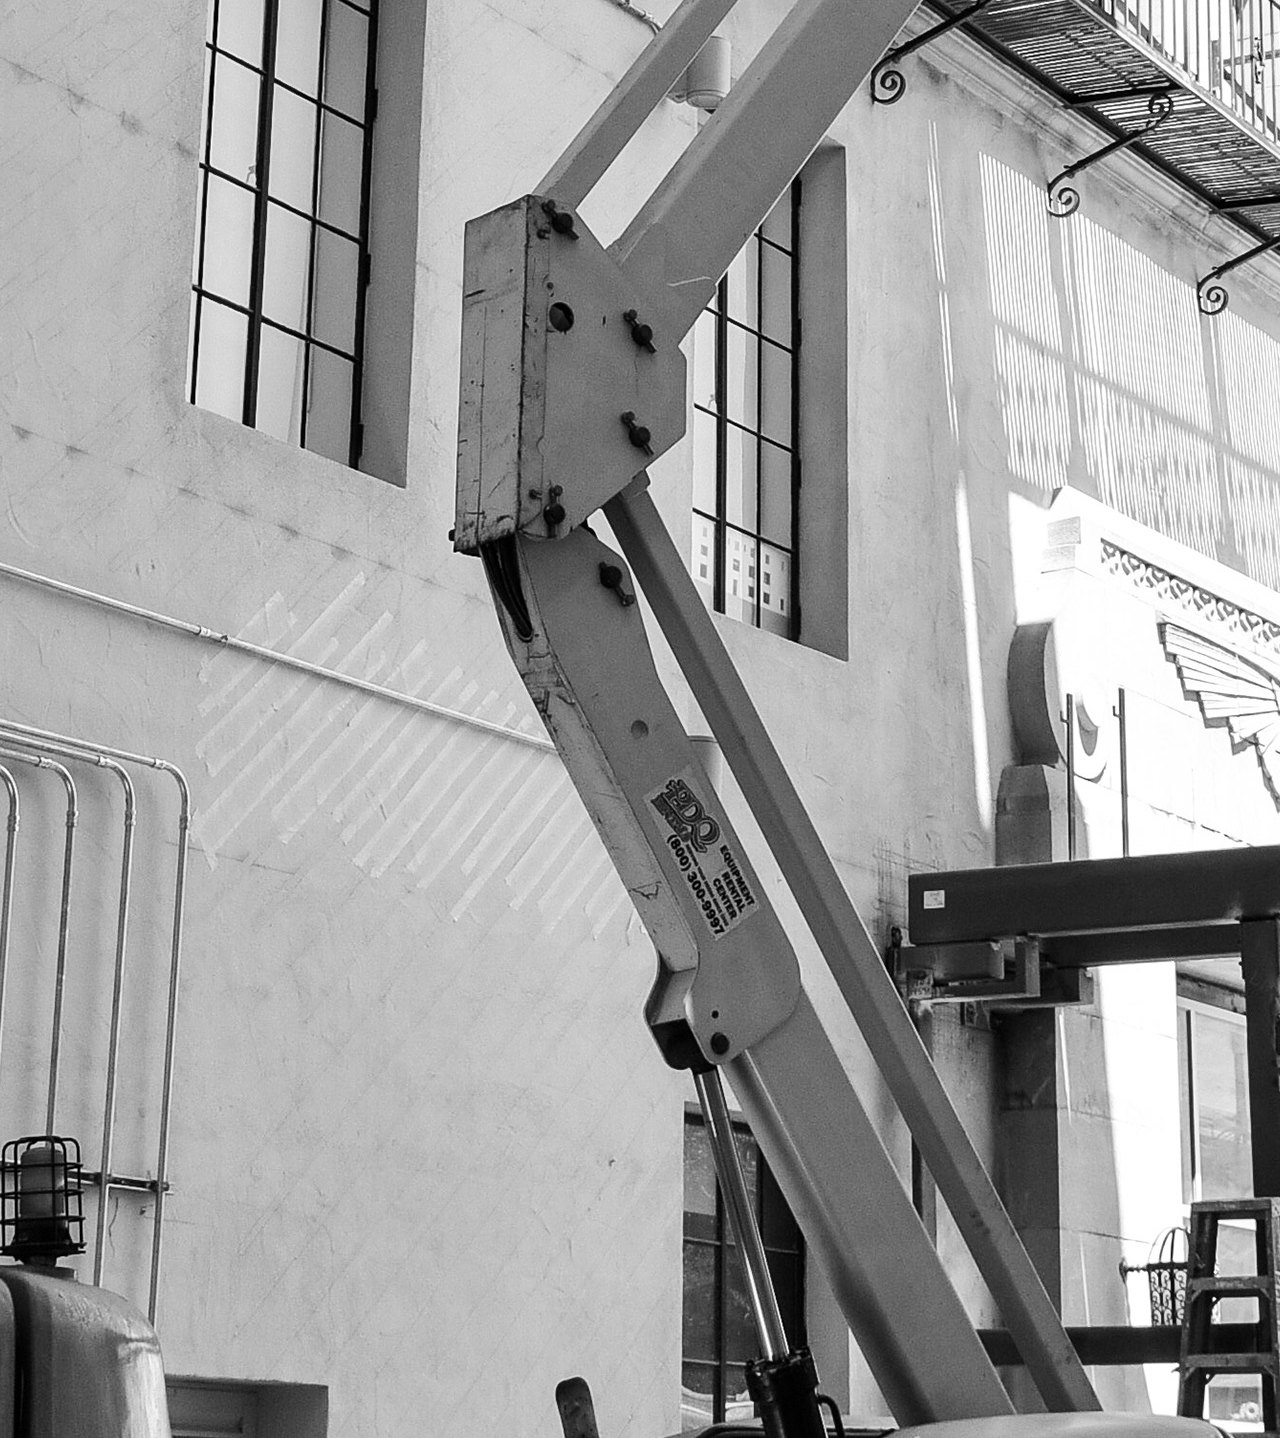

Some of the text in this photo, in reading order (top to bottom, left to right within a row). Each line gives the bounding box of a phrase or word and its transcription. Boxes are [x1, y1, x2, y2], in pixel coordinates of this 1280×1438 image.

[666, 833, 692, 872] (800)
[687, 871, 726, 935] 300-9997
[712, 877, 738, 921] CENTER
[719, 844, 756, 907] EQUIPMENT
[721, 871, 745, 914] RENTAL
